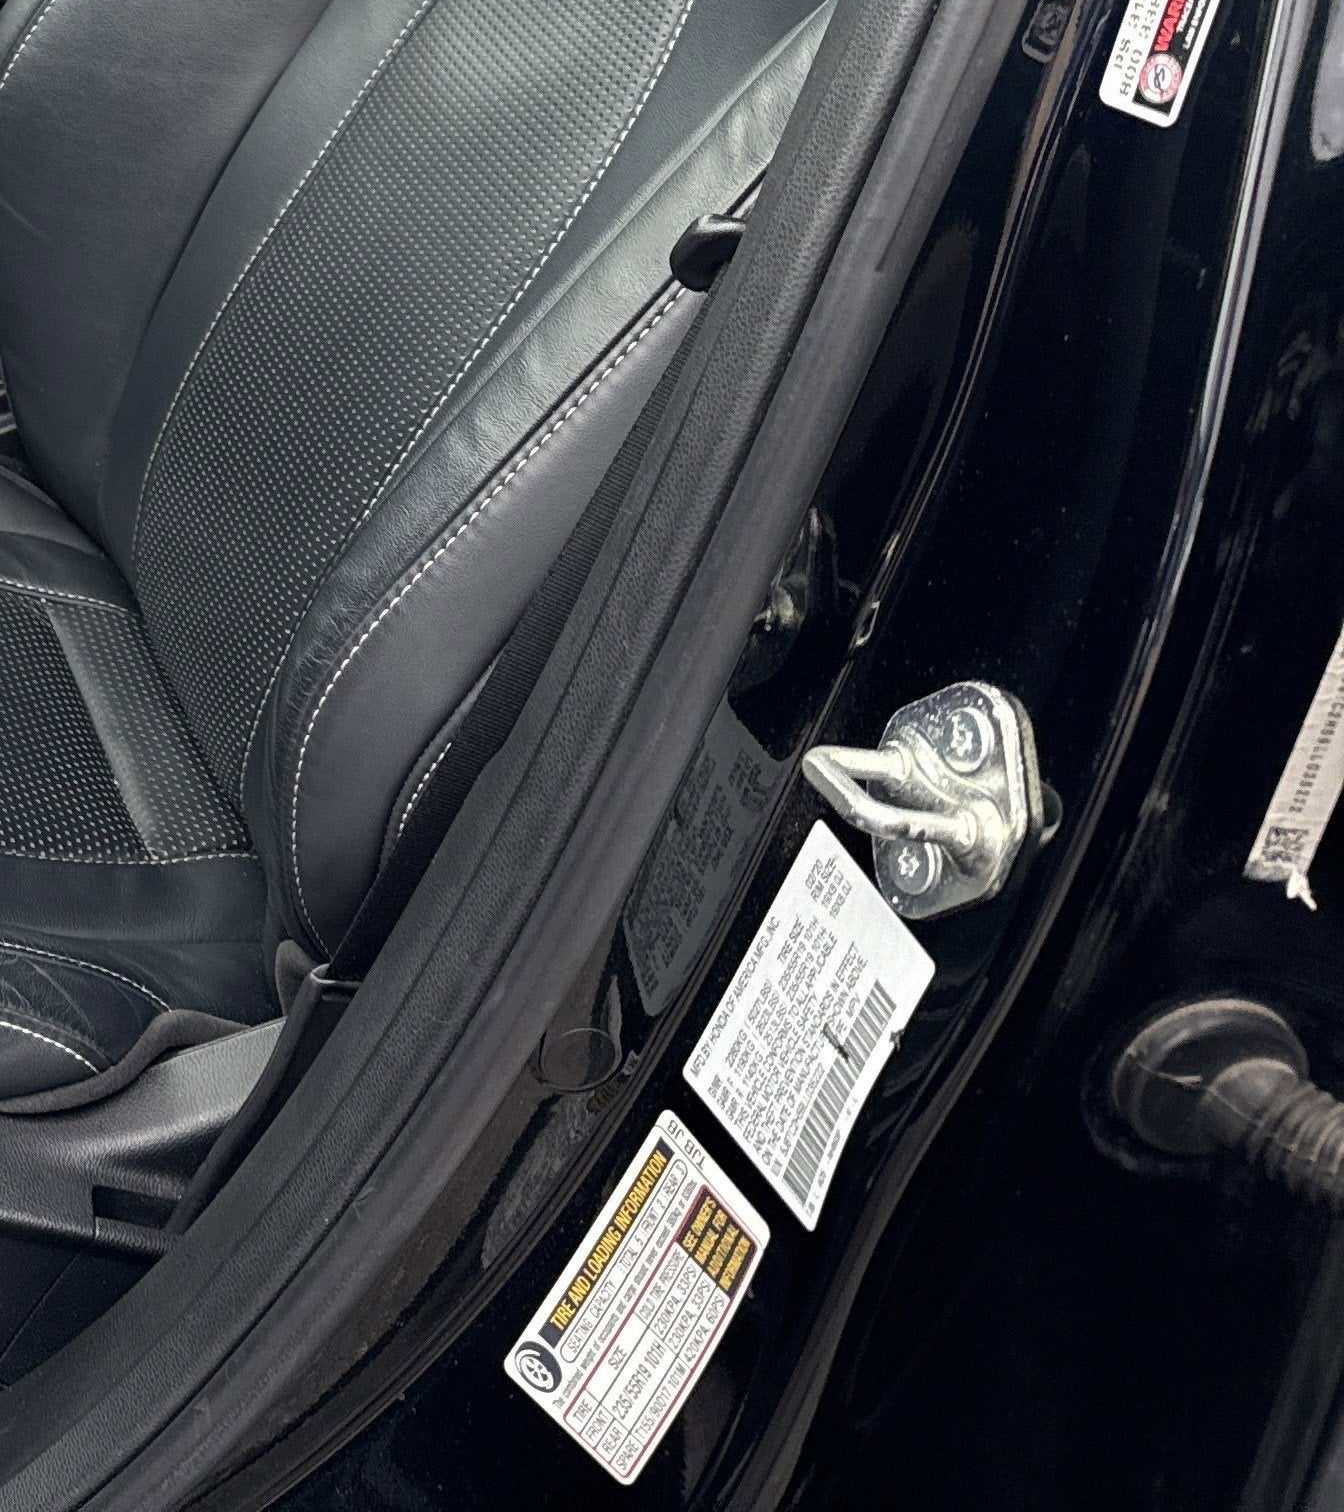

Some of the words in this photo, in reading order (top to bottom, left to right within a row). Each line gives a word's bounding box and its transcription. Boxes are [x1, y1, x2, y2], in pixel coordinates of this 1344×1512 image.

[776, 938, 793, 966] TIRE
[788, 917, 804, 944] SIZE
[810, 879, 824, 902] RIM
[819, 856, 836, 884] SIZE
[829, 977, 840, 994] IN
[834, 939, 860, 983] EFFECT
[707, 1007, 730, 1045] HONDA
[724, 994, 737, 1013] OF
[731, 954, 759, 1001] AMERICA
[801, 989, 834, 1049] STANDARDS
[825, 986, 849, 1029] SHOWN
[844, 990, 862, 1020] MPV
[733, 1105, 749, 1132] THIS
[743, 1068, 768, 1111] VEHICLE
[761, 1017, 793, 1073] CONFORMS
[787, 1002, 800, 1022] TO
[794, 986, 808, 1008] ALL
[803, 930, 837, 992] APPLICABLE
[791, 1027, 829, 1095] MANUFACTUR
[741, 1099, 767, 1144] FEDERAL
[760, 1065, 783, 1104] MOTOR
[776, 1026, 801, 1069] VEHICLE
[795, 990, 820, 1032] SAFETY
[772, 1044, 807, 1106] PREVENTION
[759, 1100, 780, 1134] THEFT
[774, 1103, 792, 1133] DATE
[785, 1089, 798, 1109] OF
[665, 1116, 685, 1143] JB
[682, 1137, 708, 1171] TJB
[751, 1129, 767, 1155] AND
[760, 1146, 774, 1167] ON
[766, 1128, 781, 1152] THE
[549, 1296, 577, 1333] TIRE
[566, 1272, 592, 1307] AND
[581, 1223, 622, 1282] LOADING
[611, 1147, 669, 1233] INFORMATION
[565, 1315, 593, 1355] SEATING
[586, 1276, 617, 1320] CAPACITY
[616, 1241, 639, 1272] TOTAL
[638, 1204, 660, 1235] FRONT
[660, 1171, 679, 1198] REAR
[585, 1409, 609, 1442] FRONT
[675, 1262, 698, 1296] 33PSI
[601, 1425, 623, 1455] REAR
[690, 1277, 712, 1310] 33PSI
[611, 1361, 652, 1422] 235/55R19
[643, 1337, 666, 1370] 101H
[615, 1438, 639, 1472] SPARE
[704, 1292, 726, 1325] 60PSI
[551, 1392, 566, 1412] The
[572, 1397, 592, 1425] TIRE
[607, 1343, 627, 1371] SIZE
